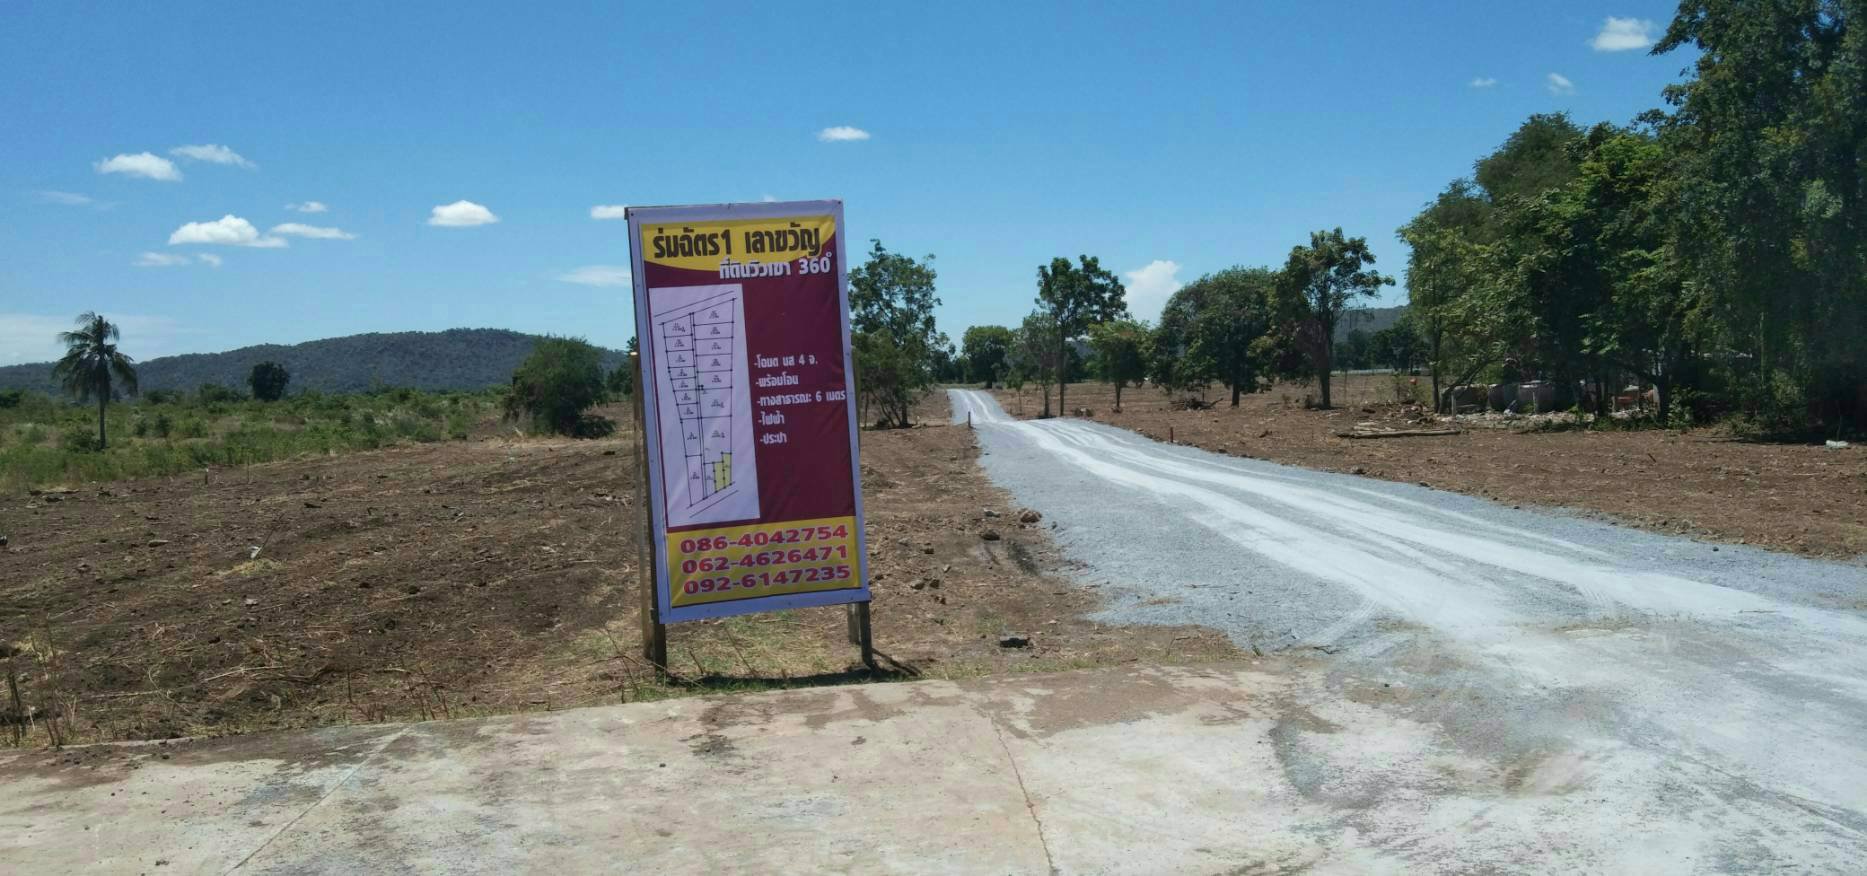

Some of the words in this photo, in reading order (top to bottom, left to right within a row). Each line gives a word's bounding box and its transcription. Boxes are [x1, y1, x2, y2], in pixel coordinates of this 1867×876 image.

[653, 227, 732, 258] ร่มฉัตร1
[744, 222, 821, 257] เลาขวัญ
[719, 258, 791, 279] ที่ดินวิวเขา
[798, 354, 806, 365] 4
[815, 391, 822, 402] 6
[825, 390, 846, 402] เมตร
[680, 524, 848, 553] 086-4042754
[681, 544, 848, 574] 062-4626471
[683, 564, 850, 594] 092-6147235
